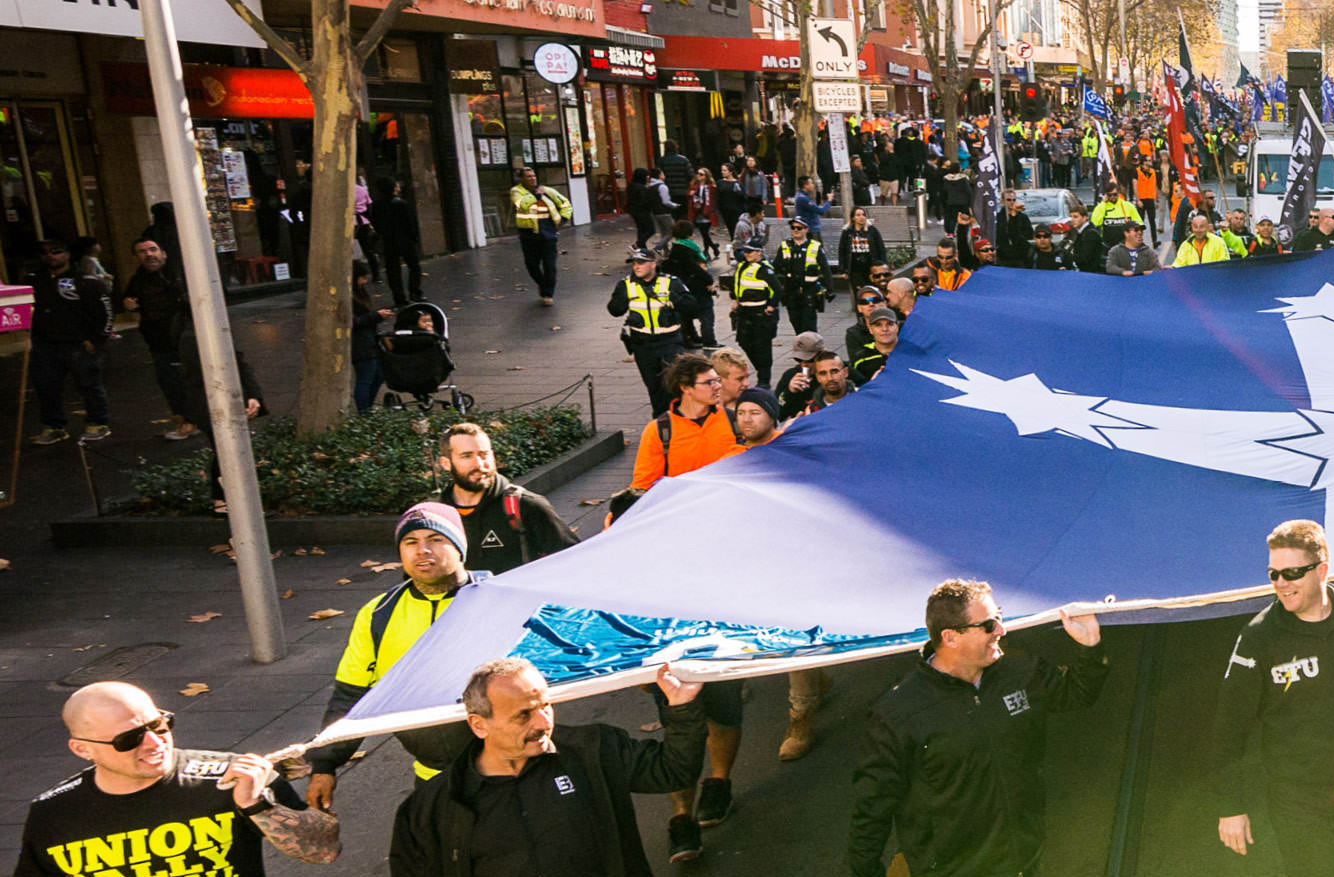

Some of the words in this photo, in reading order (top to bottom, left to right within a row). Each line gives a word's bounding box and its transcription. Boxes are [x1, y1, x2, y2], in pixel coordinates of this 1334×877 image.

[815, 61, 852, 72] ONLY
[817, 87, 856, 96] BICYCLES
[818, 98, 858, 107] EXCEPTED
[1271, 656, 1319, 684] ETU
[184, 759, 230, 776] ETU
[46, 811, 233, 874] UNION
